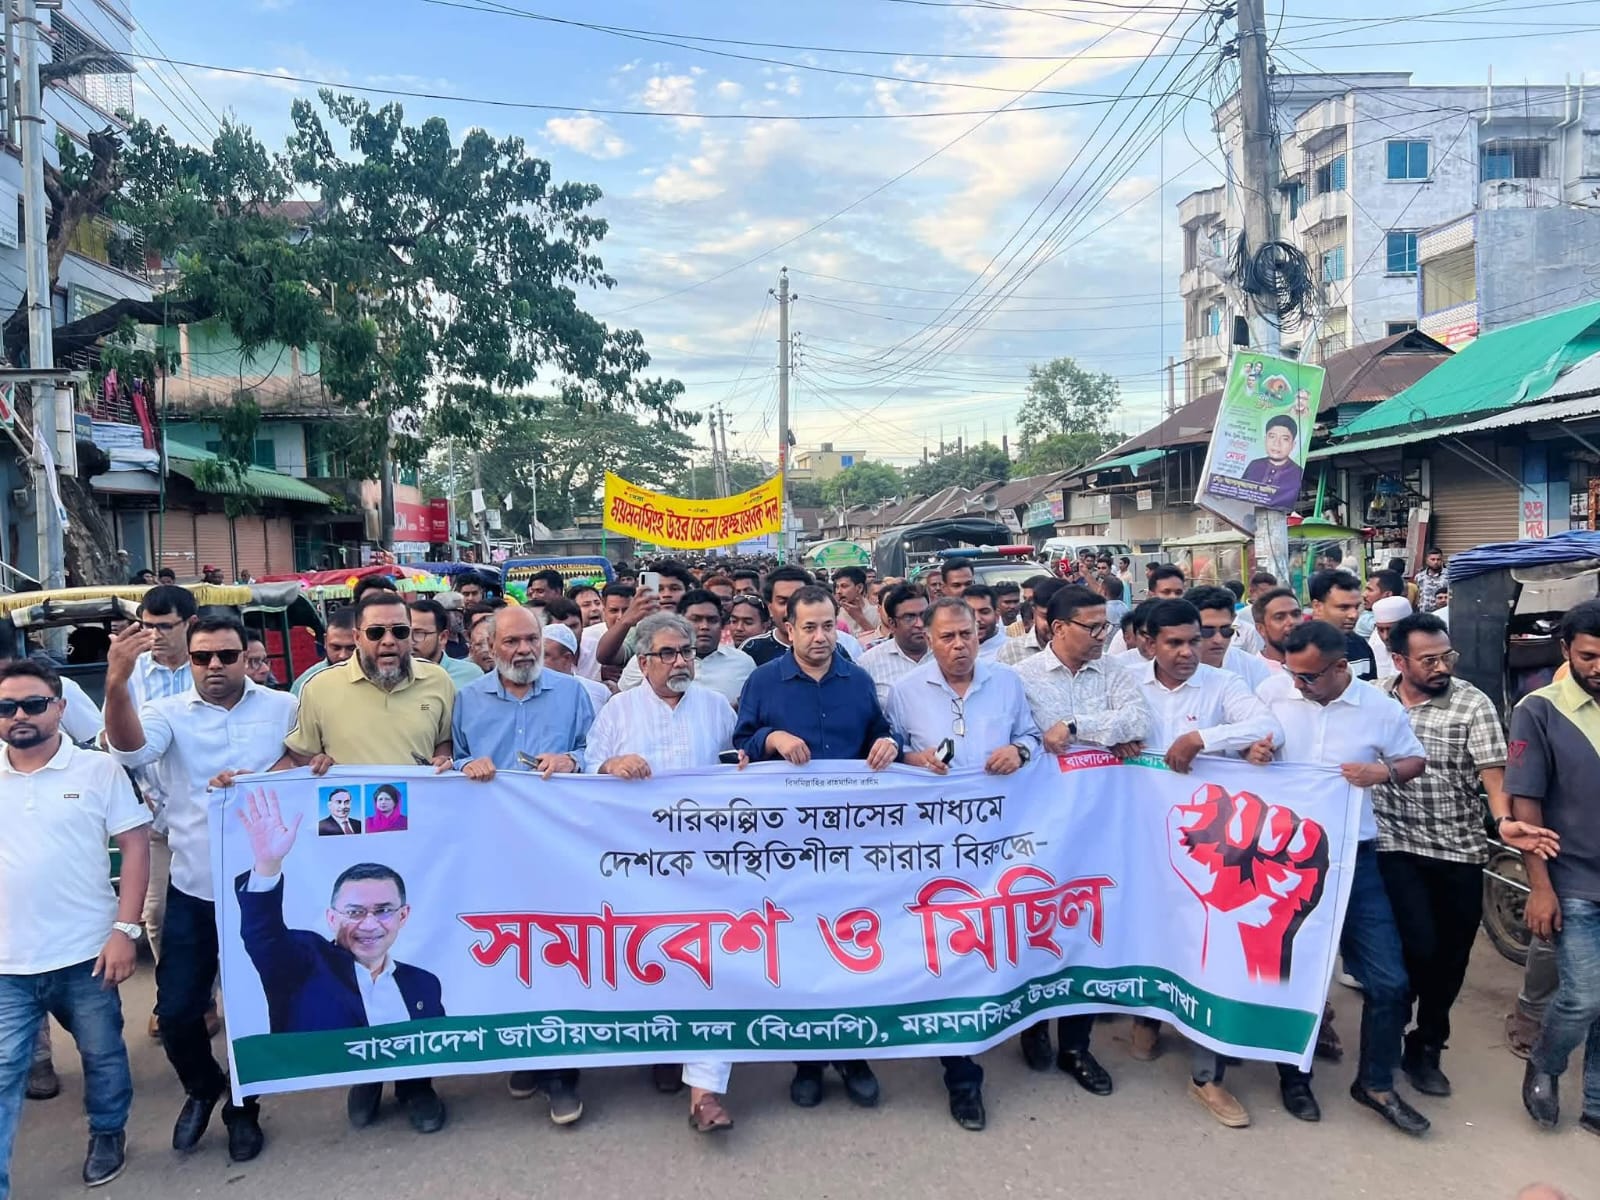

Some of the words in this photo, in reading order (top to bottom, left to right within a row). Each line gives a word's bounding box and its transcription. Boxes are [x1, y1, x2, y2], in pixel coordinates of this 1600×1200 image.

[610, 496, 666, 538] ময়মনসিংহ
[666, 508, 691, 541] উত্তর
[690, 516, 719, 543] জেলা
[764, 496, 779, 526] দল
[651, 798, 787, 835] পরিকল্পিত
[797, 800, 909, 831] সন্ত্রাসের
[917, 795, 1006, 828] মাধ্যমে
[599, 847, 696, 878] দেশকে
[704, 837, 855, 882] অস্থিতিশীল
[861, 839, 945, 872] কারার
[456, 899, 793, 989] সমাবেশ
[815, 906, 885, 974] ও
[903, 864, 1118, 978] মিছিল
[344, 1026, 488, 1061] বাংলাদেশ
[495, 1014, 682, 1051] জাতীয়তাবাদী
[688, 1020, 737, 1044] দল
[746, 1013, 890, 1048] (বিএনপি),
[897, 994, 1021, 1037] ময়মনসিংহ
[1027, 976, 1075, 1005] উত্তর
[1082, 974, 1148, 1000] জেলা
[1155, 979, 1199, 1020] শাখা
